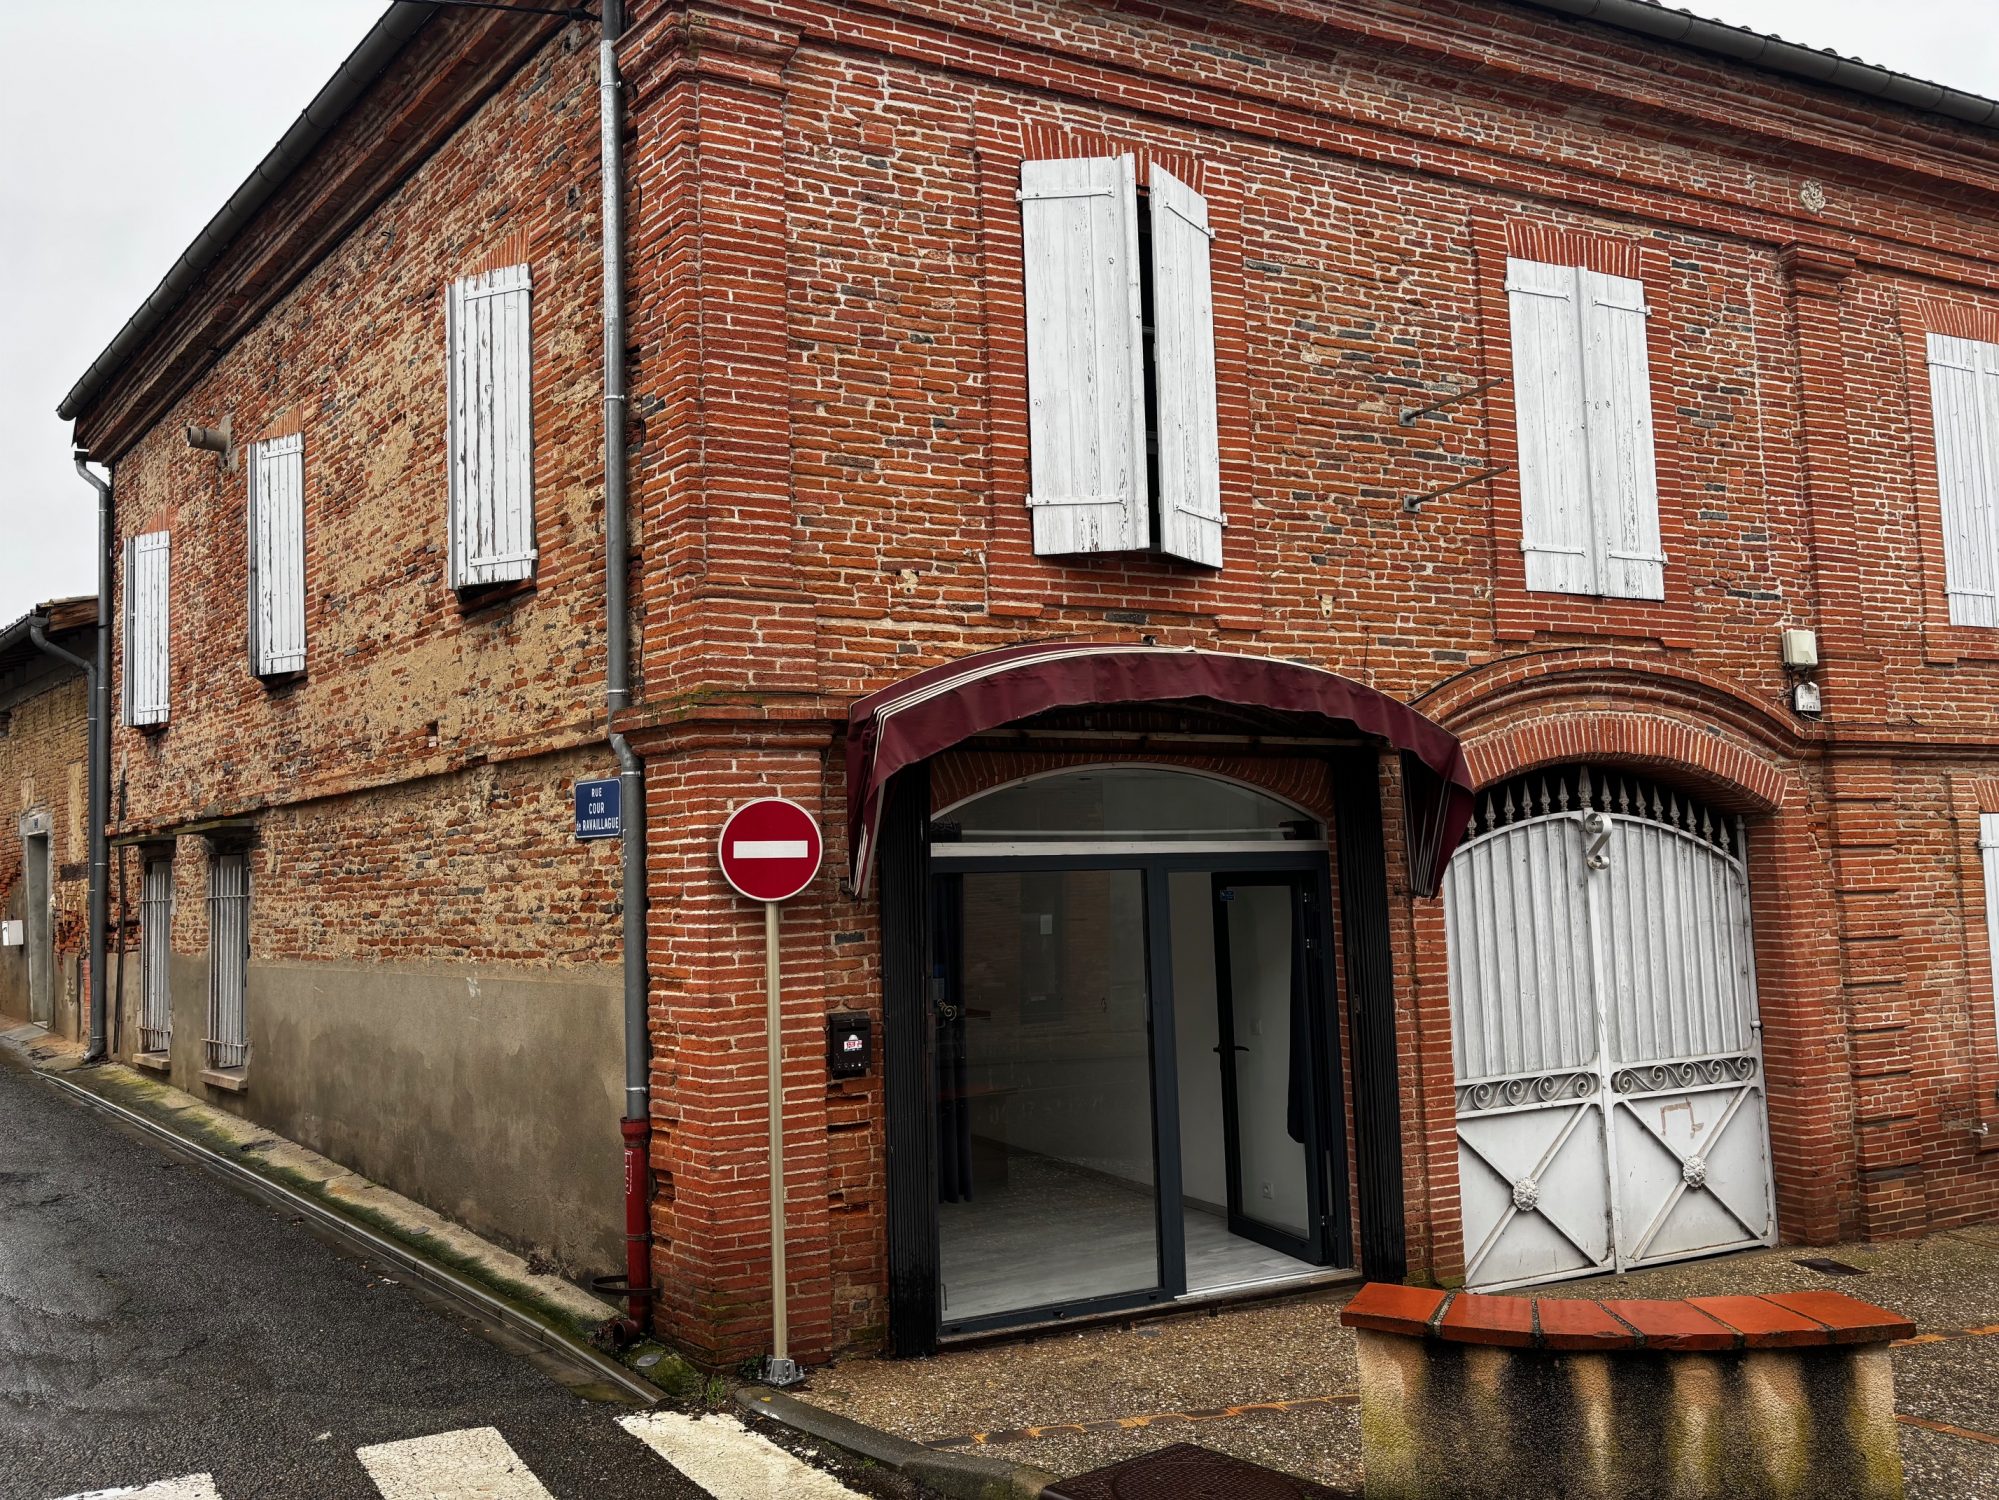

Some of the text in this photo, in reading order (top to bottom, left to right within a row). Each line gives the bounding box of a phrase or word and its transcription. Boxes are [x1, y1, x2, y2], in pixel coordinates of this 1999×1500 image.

[591, 787, 602, 797] RUE
[588, 802, 605, 815] COUR
[582, 816, 619, 831] RAVAILLAGUE
